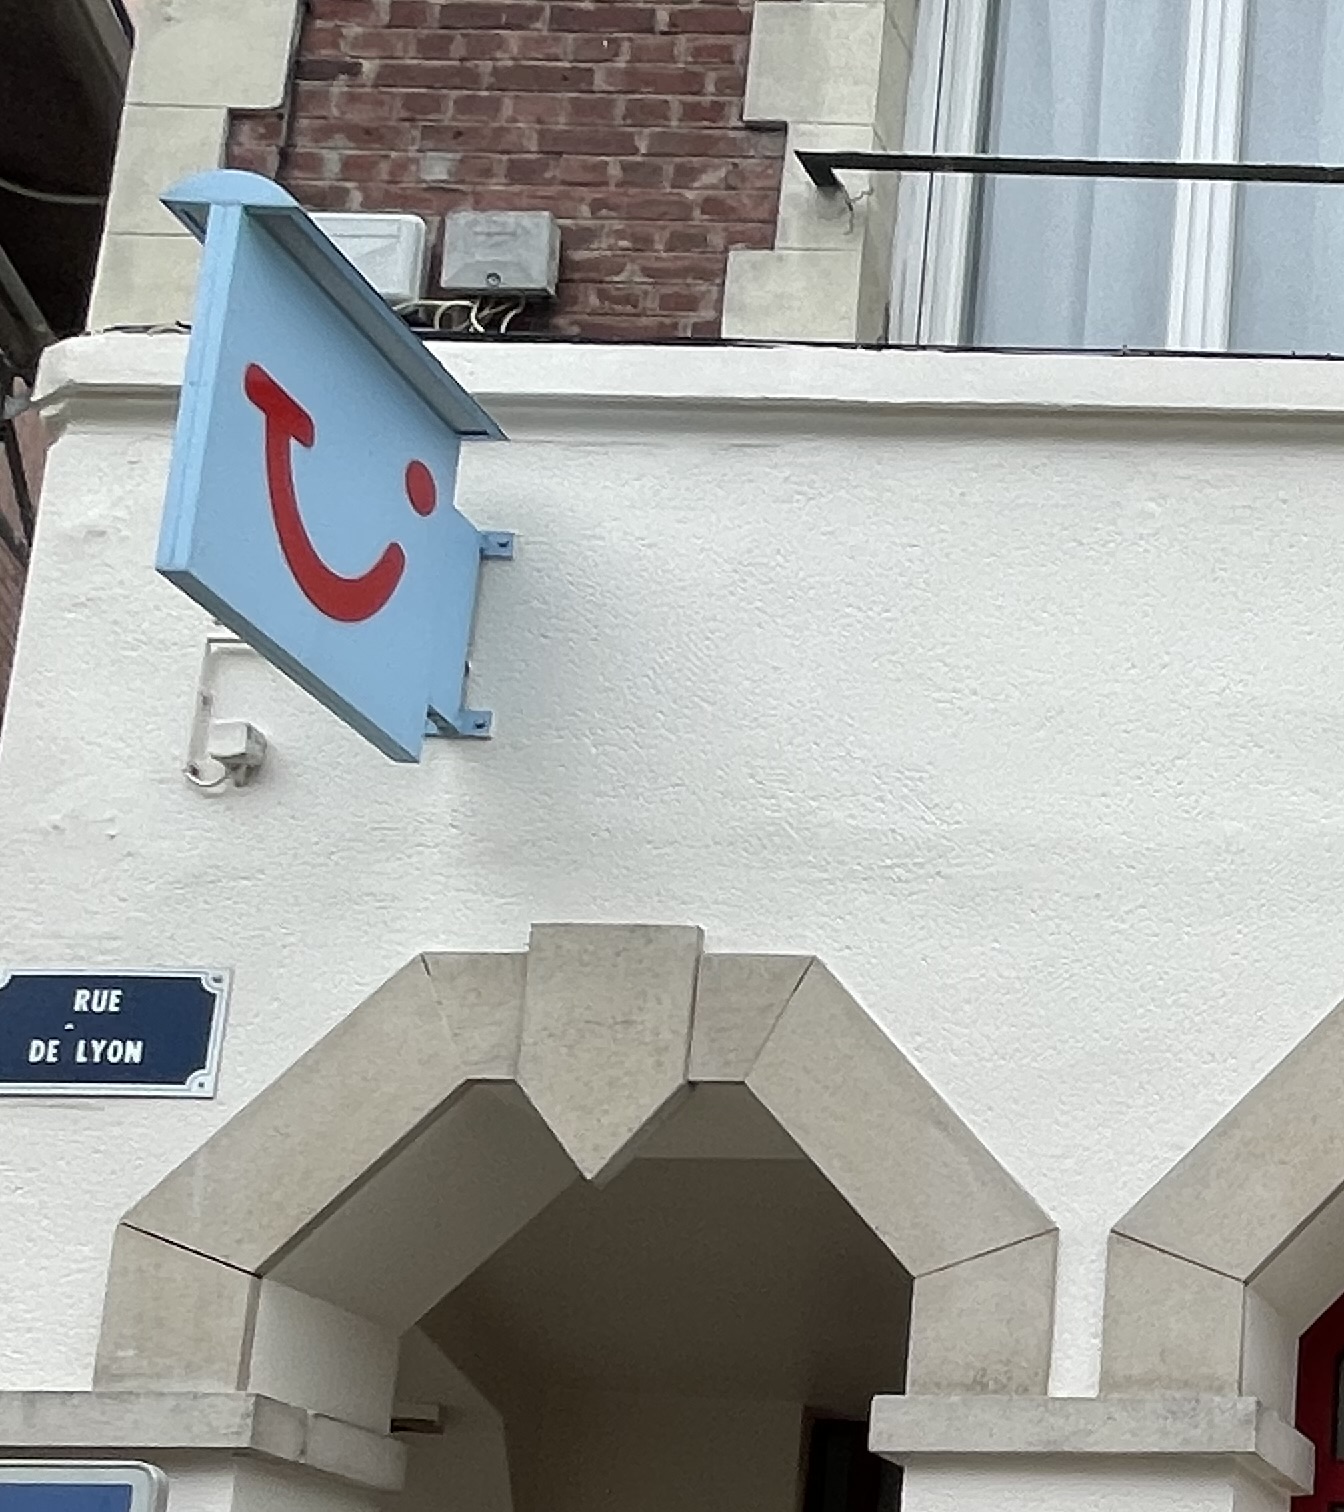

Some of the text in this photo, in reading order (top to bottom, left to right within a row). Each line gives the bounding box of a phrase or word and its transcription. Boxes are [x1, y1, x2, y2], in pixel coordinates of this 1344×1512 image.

[73, 988, 122, 1013] RUE
[28, 1039, 143, 1064] DE LYON
